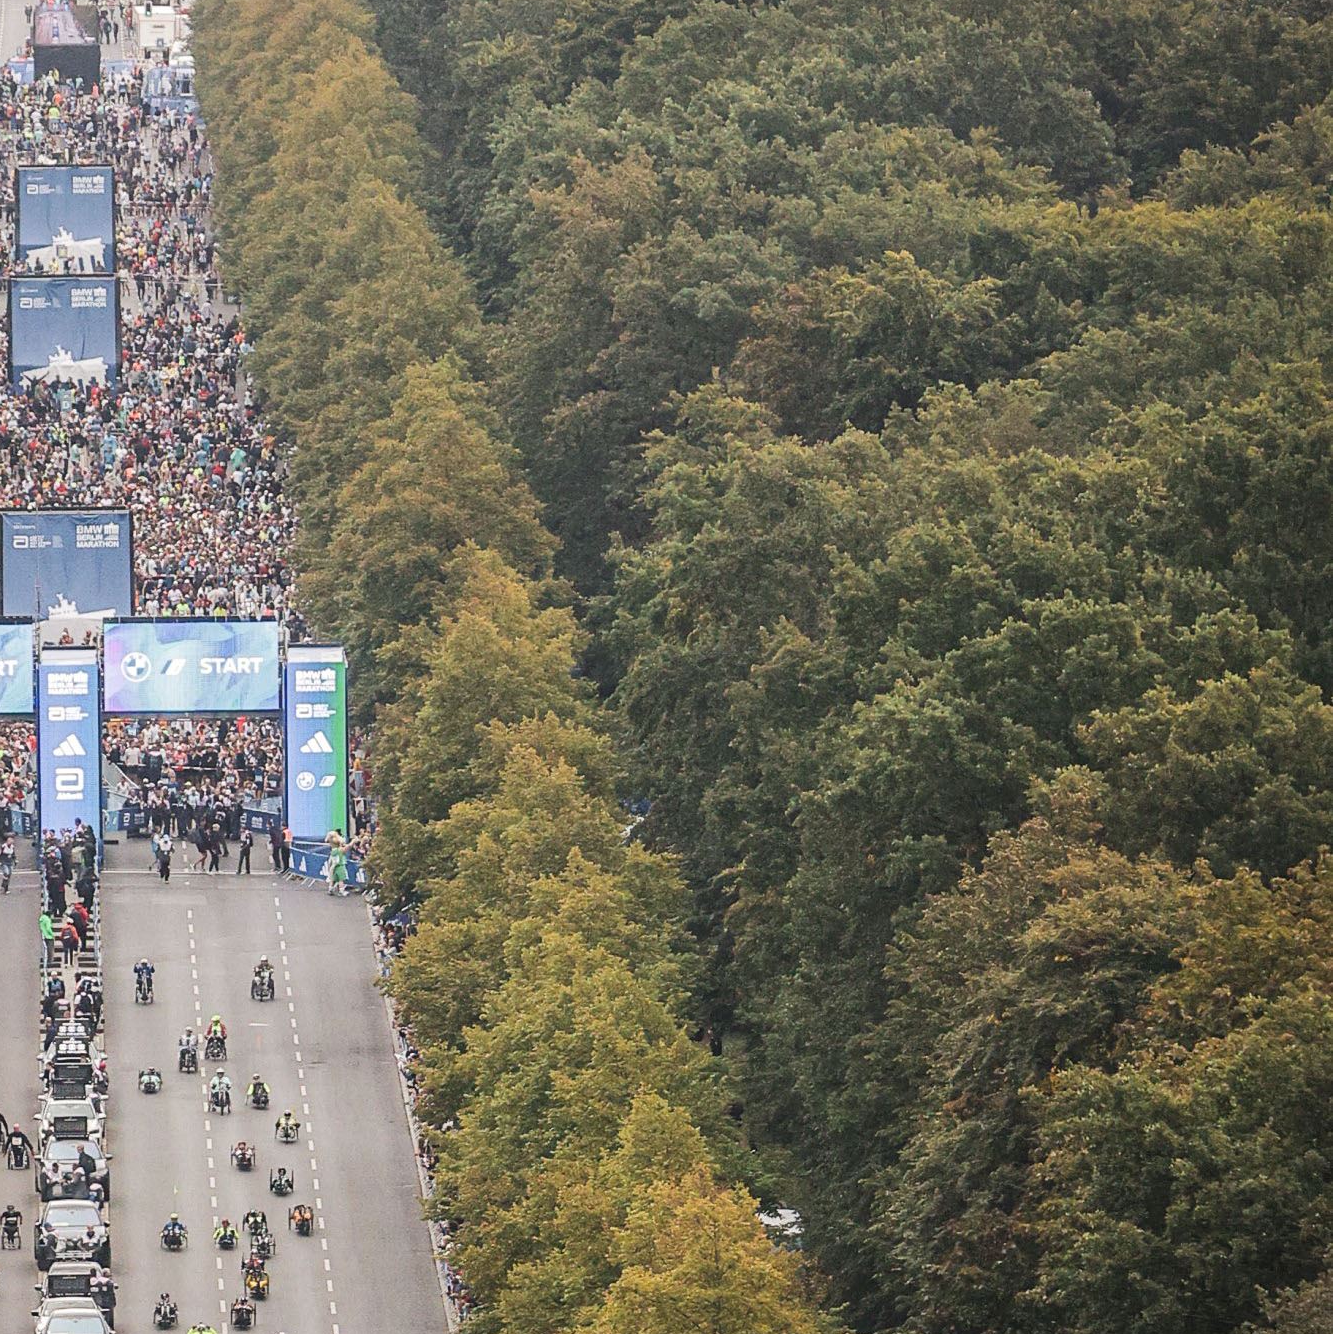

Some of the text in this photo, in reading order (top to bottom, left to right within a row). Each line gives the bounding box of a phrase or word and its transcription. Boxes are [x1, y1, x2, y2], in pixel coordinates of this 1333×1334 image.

[71, 288, 93, 296] BMW
[76, 524, 102, 534] BMW
[76, 540, 119, 548] MARATHON
[200, 657, 263, 674] START
[47, 673, 73, 682] BMW
[295, 670, 321, 679] BMW
